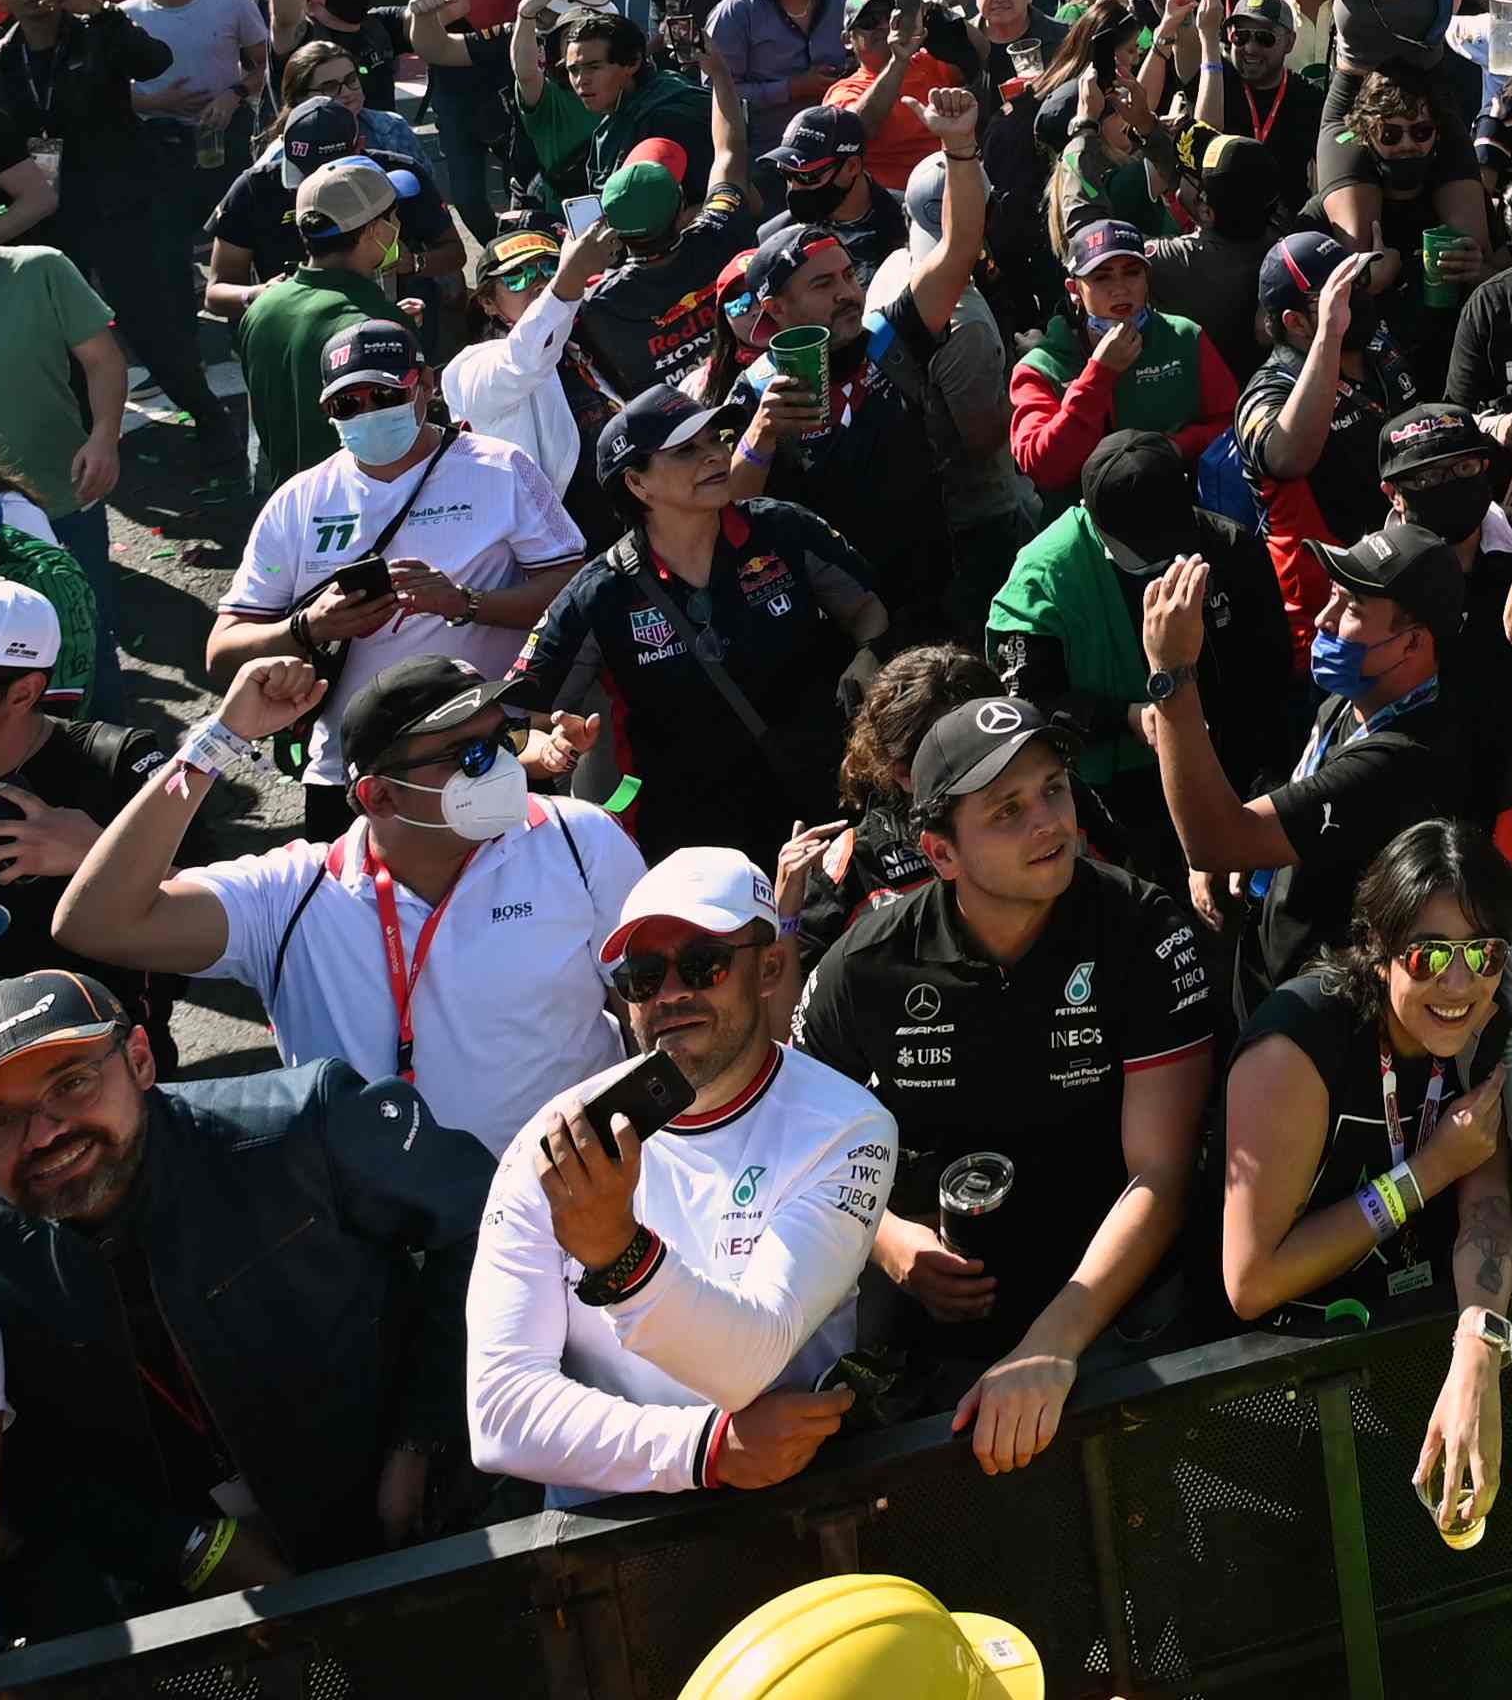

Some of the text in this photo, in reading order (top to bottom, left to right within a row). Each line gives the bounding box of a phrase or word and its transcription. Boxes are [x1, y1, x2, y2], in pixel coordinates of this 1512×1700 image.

[328, 344, 352, 370] 11
[315, 524, 357, 554] 11
[637, 645, 674, 668] Mobil
[131, 750, 166, 774] EPSO
[492, 902, 534, 920] BOSS
[1154, 924, 1196, 961] EPSON
[1173, 947, 1199, 971] IWC
[1049, 1028, 1104, 1050] INEOS
[917, 1046, 953, 1065] UBS
[860, 1164, 884, 1186] IWC
